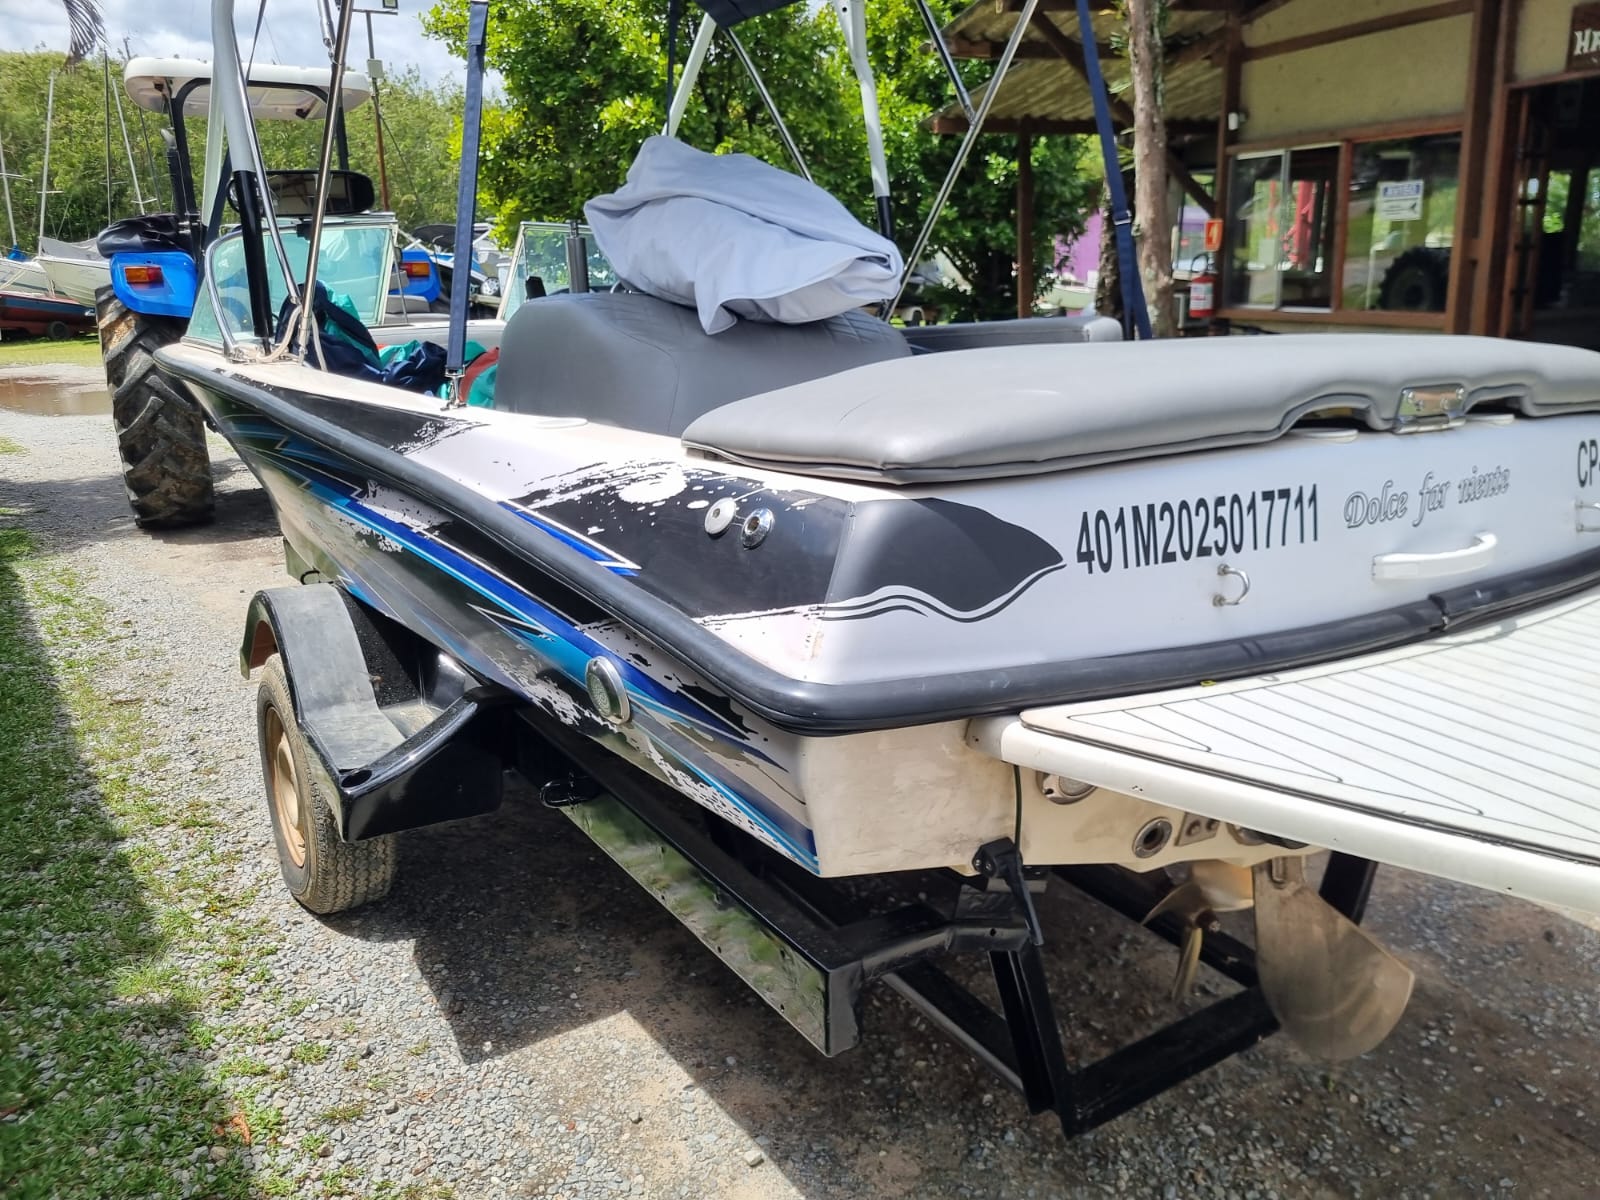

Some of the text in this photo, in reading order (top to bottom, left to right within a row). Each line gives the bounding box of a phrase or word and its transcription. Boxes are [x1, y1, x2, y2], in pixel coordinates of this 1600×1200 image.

[1577, 439, 1600, 488] CP
[1076, 483, 1318, 575] 401M2025017711
[1344, 465, 1511, 529] Dolce far niente
